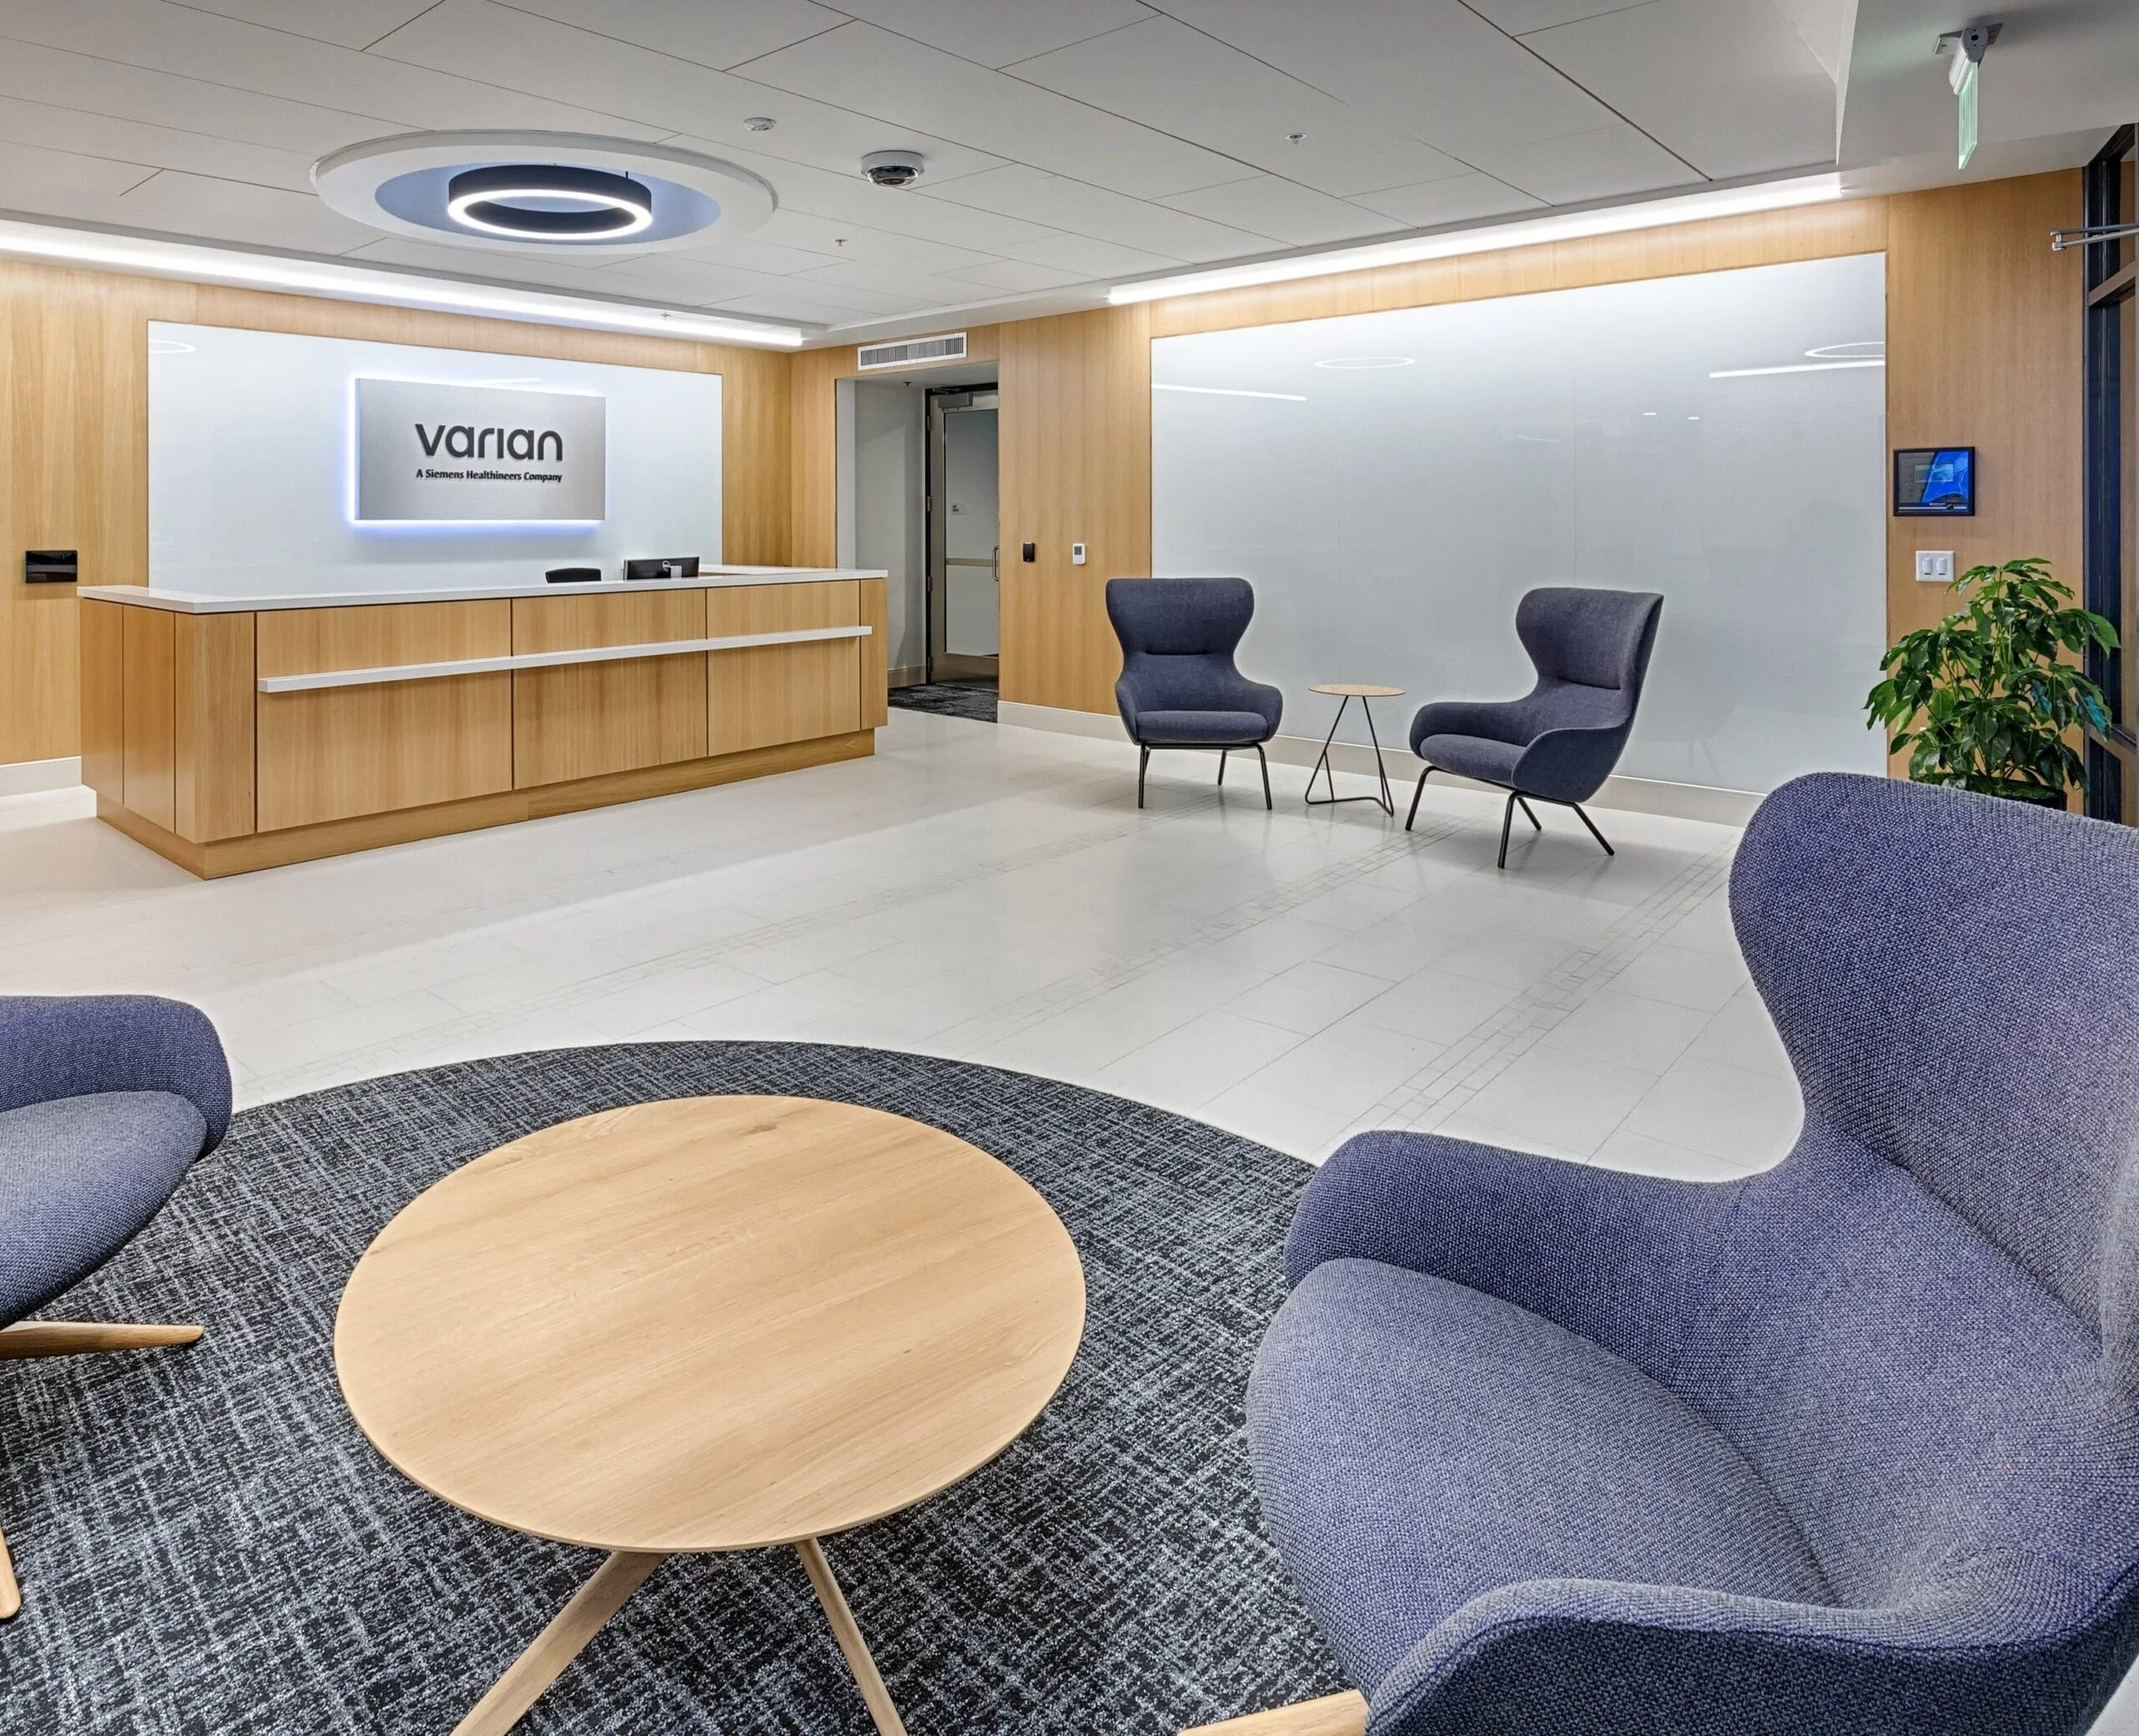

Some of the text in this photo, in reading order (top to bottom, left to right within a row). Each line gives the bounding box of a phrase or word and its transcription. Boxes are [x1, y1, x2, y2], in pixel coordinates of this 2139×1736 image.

[415, 424, 563, 461] varian
[416, 469, 562, 483] A Siemens Healthineers Company
